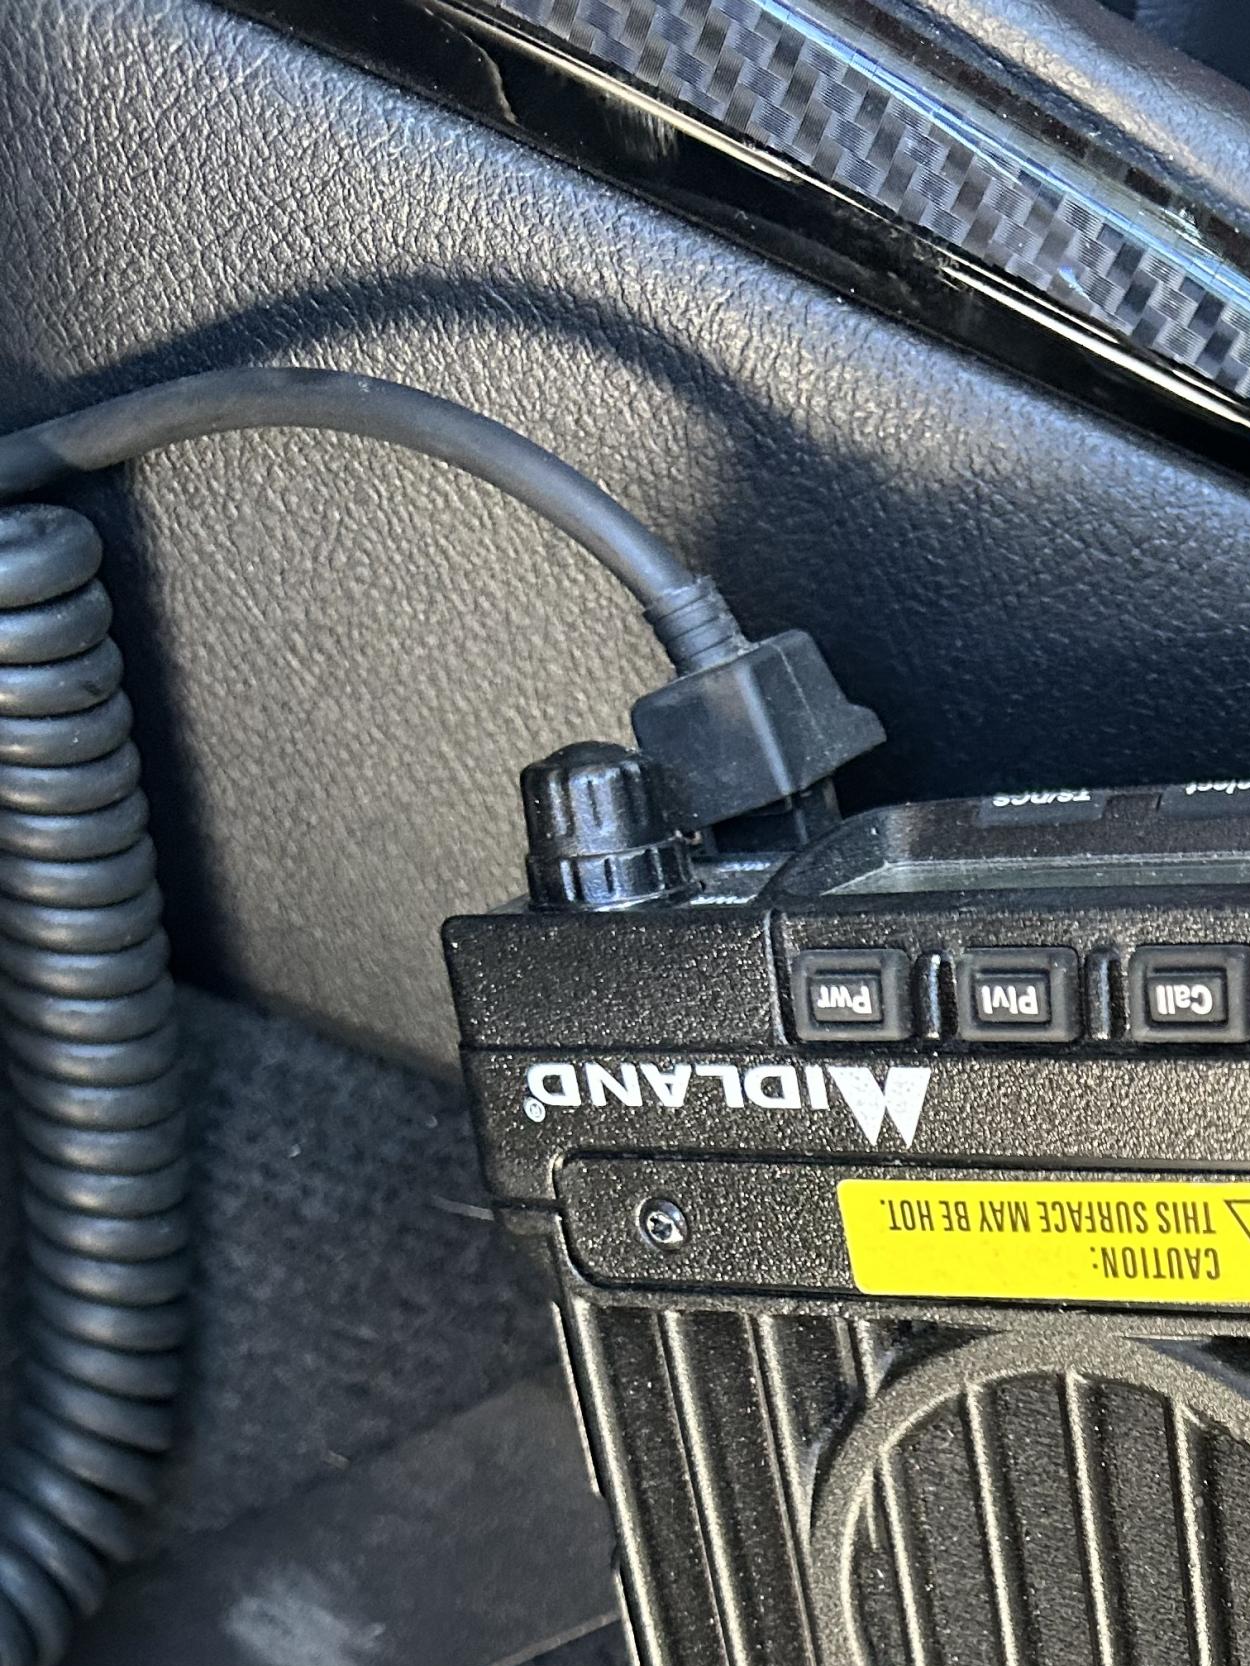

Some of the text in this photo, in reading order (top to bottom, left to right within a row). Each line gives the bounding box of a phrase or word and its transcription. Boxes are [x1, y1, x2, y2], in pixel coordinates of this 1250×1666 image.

[816, 984, 873, 1015] Pwr
[981, 985, 1039, 1016] Plvl
[1155, 984, 1214, 1016] Call
[879, 1199, 1217, 1235] THIS SURFACE MAY BE HOT.
[1089, 1245, 1222, 1281] CAUTION:
